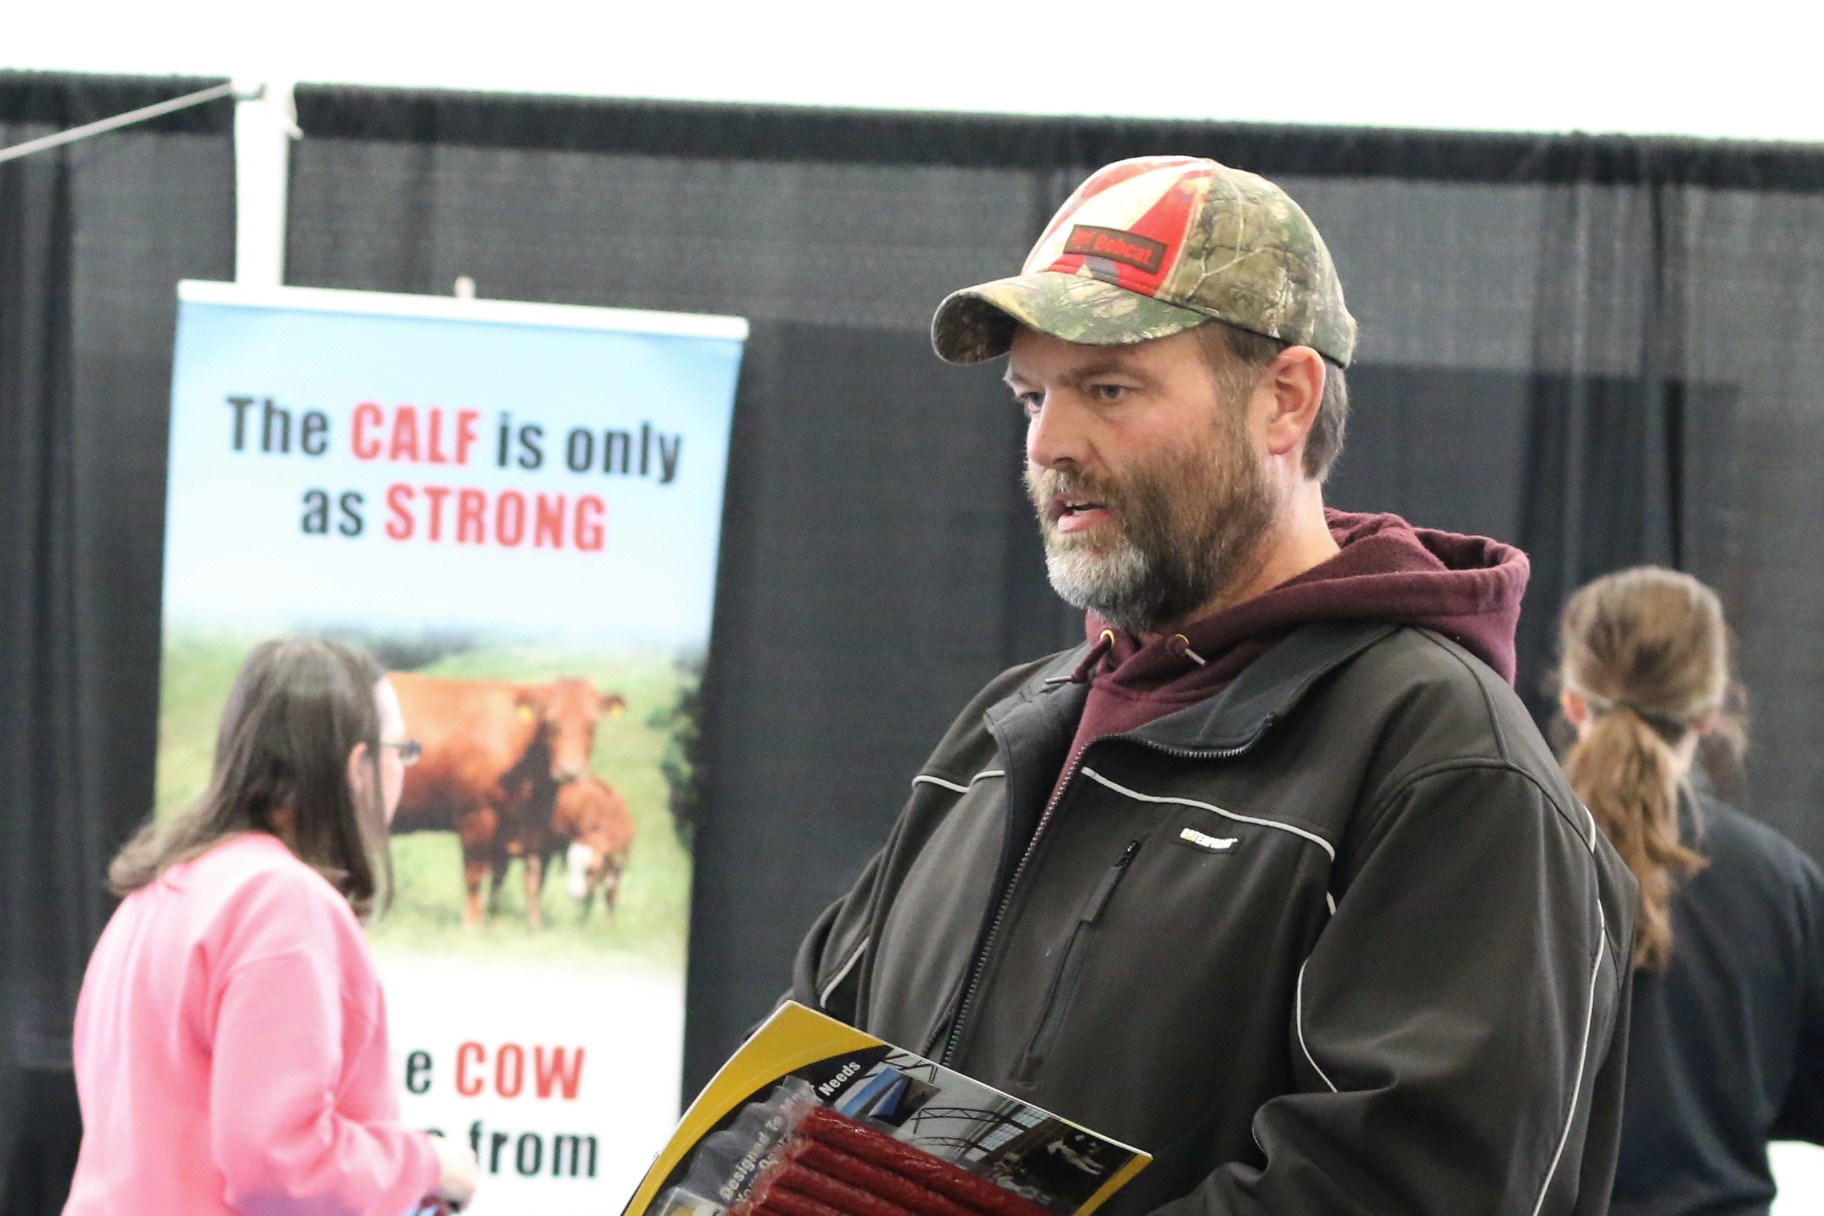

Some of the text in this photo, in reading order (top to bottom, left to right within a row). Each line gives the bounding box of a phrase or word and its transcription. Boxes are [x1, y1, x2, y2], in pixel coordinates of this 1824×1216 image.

[227, 396, 682, 484] The CALF is only
[300, 482, 606, 552] as STRONG
[455, 1041, 585, 1099] COW
[818, 1060, 862, 1098] Needs
[469, 1119, 598, 1178] from
[718, 1131, 771, 1202] Designed
